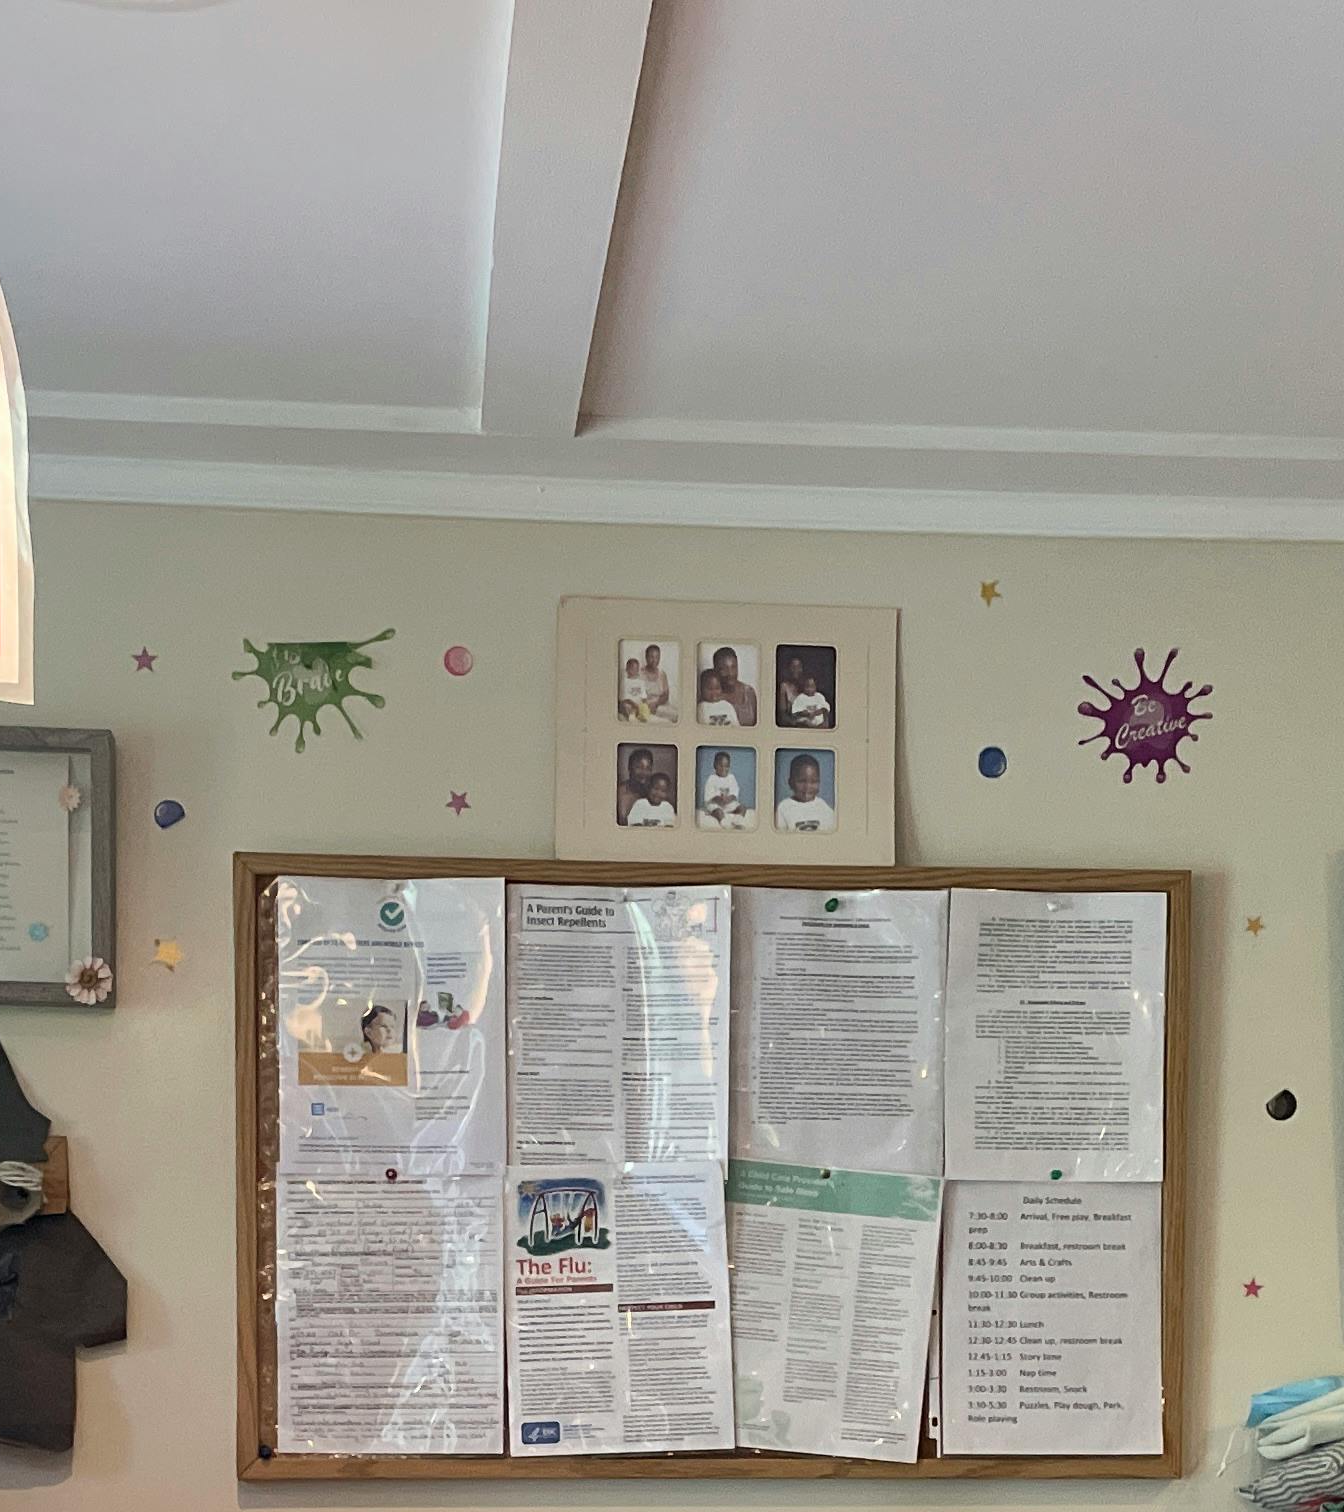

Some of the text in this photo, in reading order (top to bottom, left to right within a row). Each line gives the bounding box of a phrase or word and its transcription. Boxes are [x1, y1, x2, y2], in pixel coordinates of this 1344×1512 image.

[1131, 694, 1156, 716] Be
[1115, 716, 1187, 750] Creative
[527, 903, 615, 917] A Parent's Guide to
[527, 916, 607, 929] Insect Repellents
[1023, 1196, 1043, 1205] Daily
[1094, 1213, 1132, 1221] Breakfast
[516, 1257, 592, 1275] The Flu:
[1020, 1258, 1037, 1266] Arts
[1045, 1276, 1055, 1284] up
[1020, 1291, 1045, 1300] Group
[1088, 1291, 1128, 1299] Restroom
[1020, 1337, 1043, 1345] Clean
[1020, 1369, 1036, 1378] Nap
[1038, 1369, 1056, 1377] time
[1064, 1385, 1087, 1393] Snack
[1054, 1402, 1071, 1411] Play
[968, 1415, 985, 1423] Role
